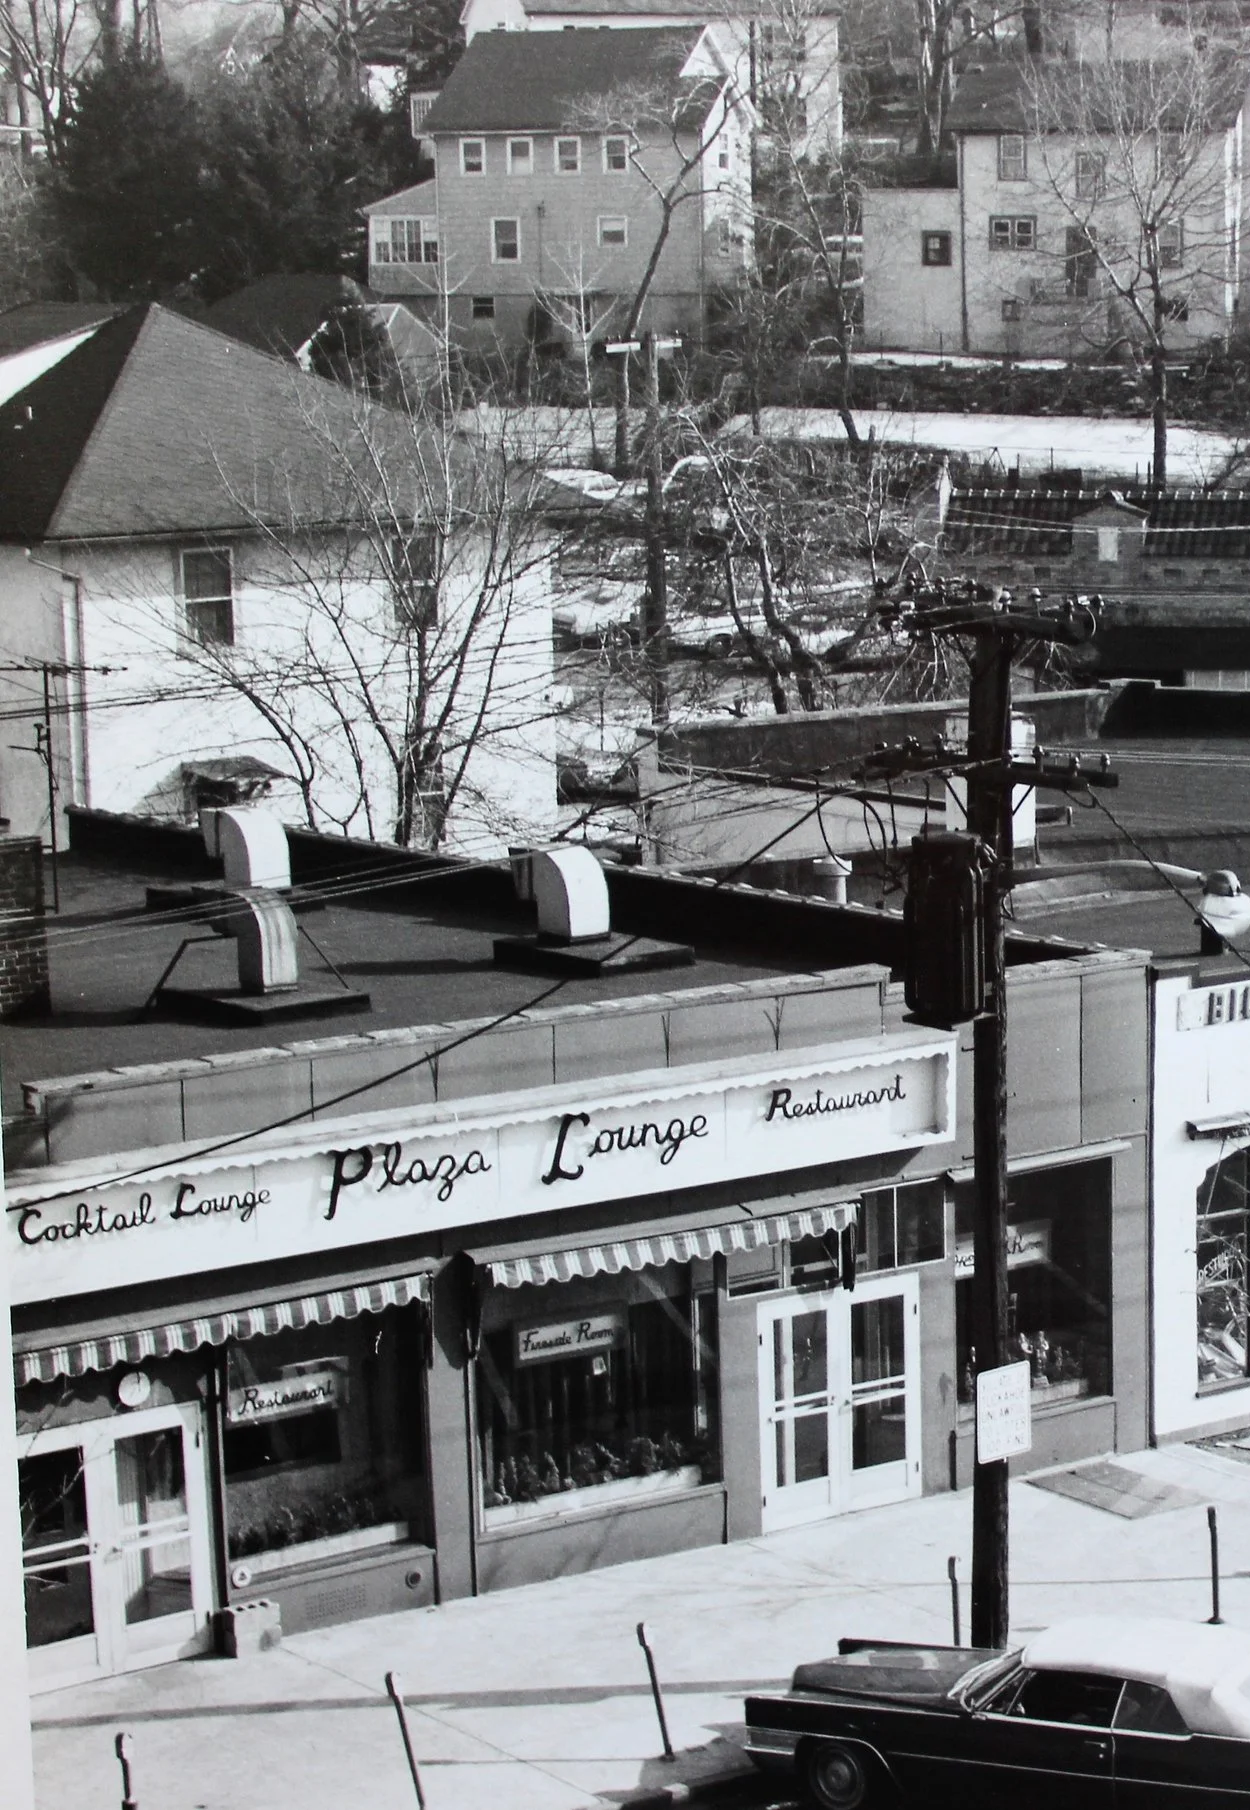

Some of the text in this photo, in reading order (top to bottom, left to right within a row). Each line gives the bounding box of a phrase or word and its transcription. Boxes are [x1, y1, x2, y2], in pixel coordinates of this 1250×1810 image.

[765, 1074, 907, 1122] Restaurant
[324, 1112, 710, 1221] Plaza Lounge
[17, 1183, 271, 1246] Cocktail Lounge
[238, 1379, 334, 1416] Restaurant
